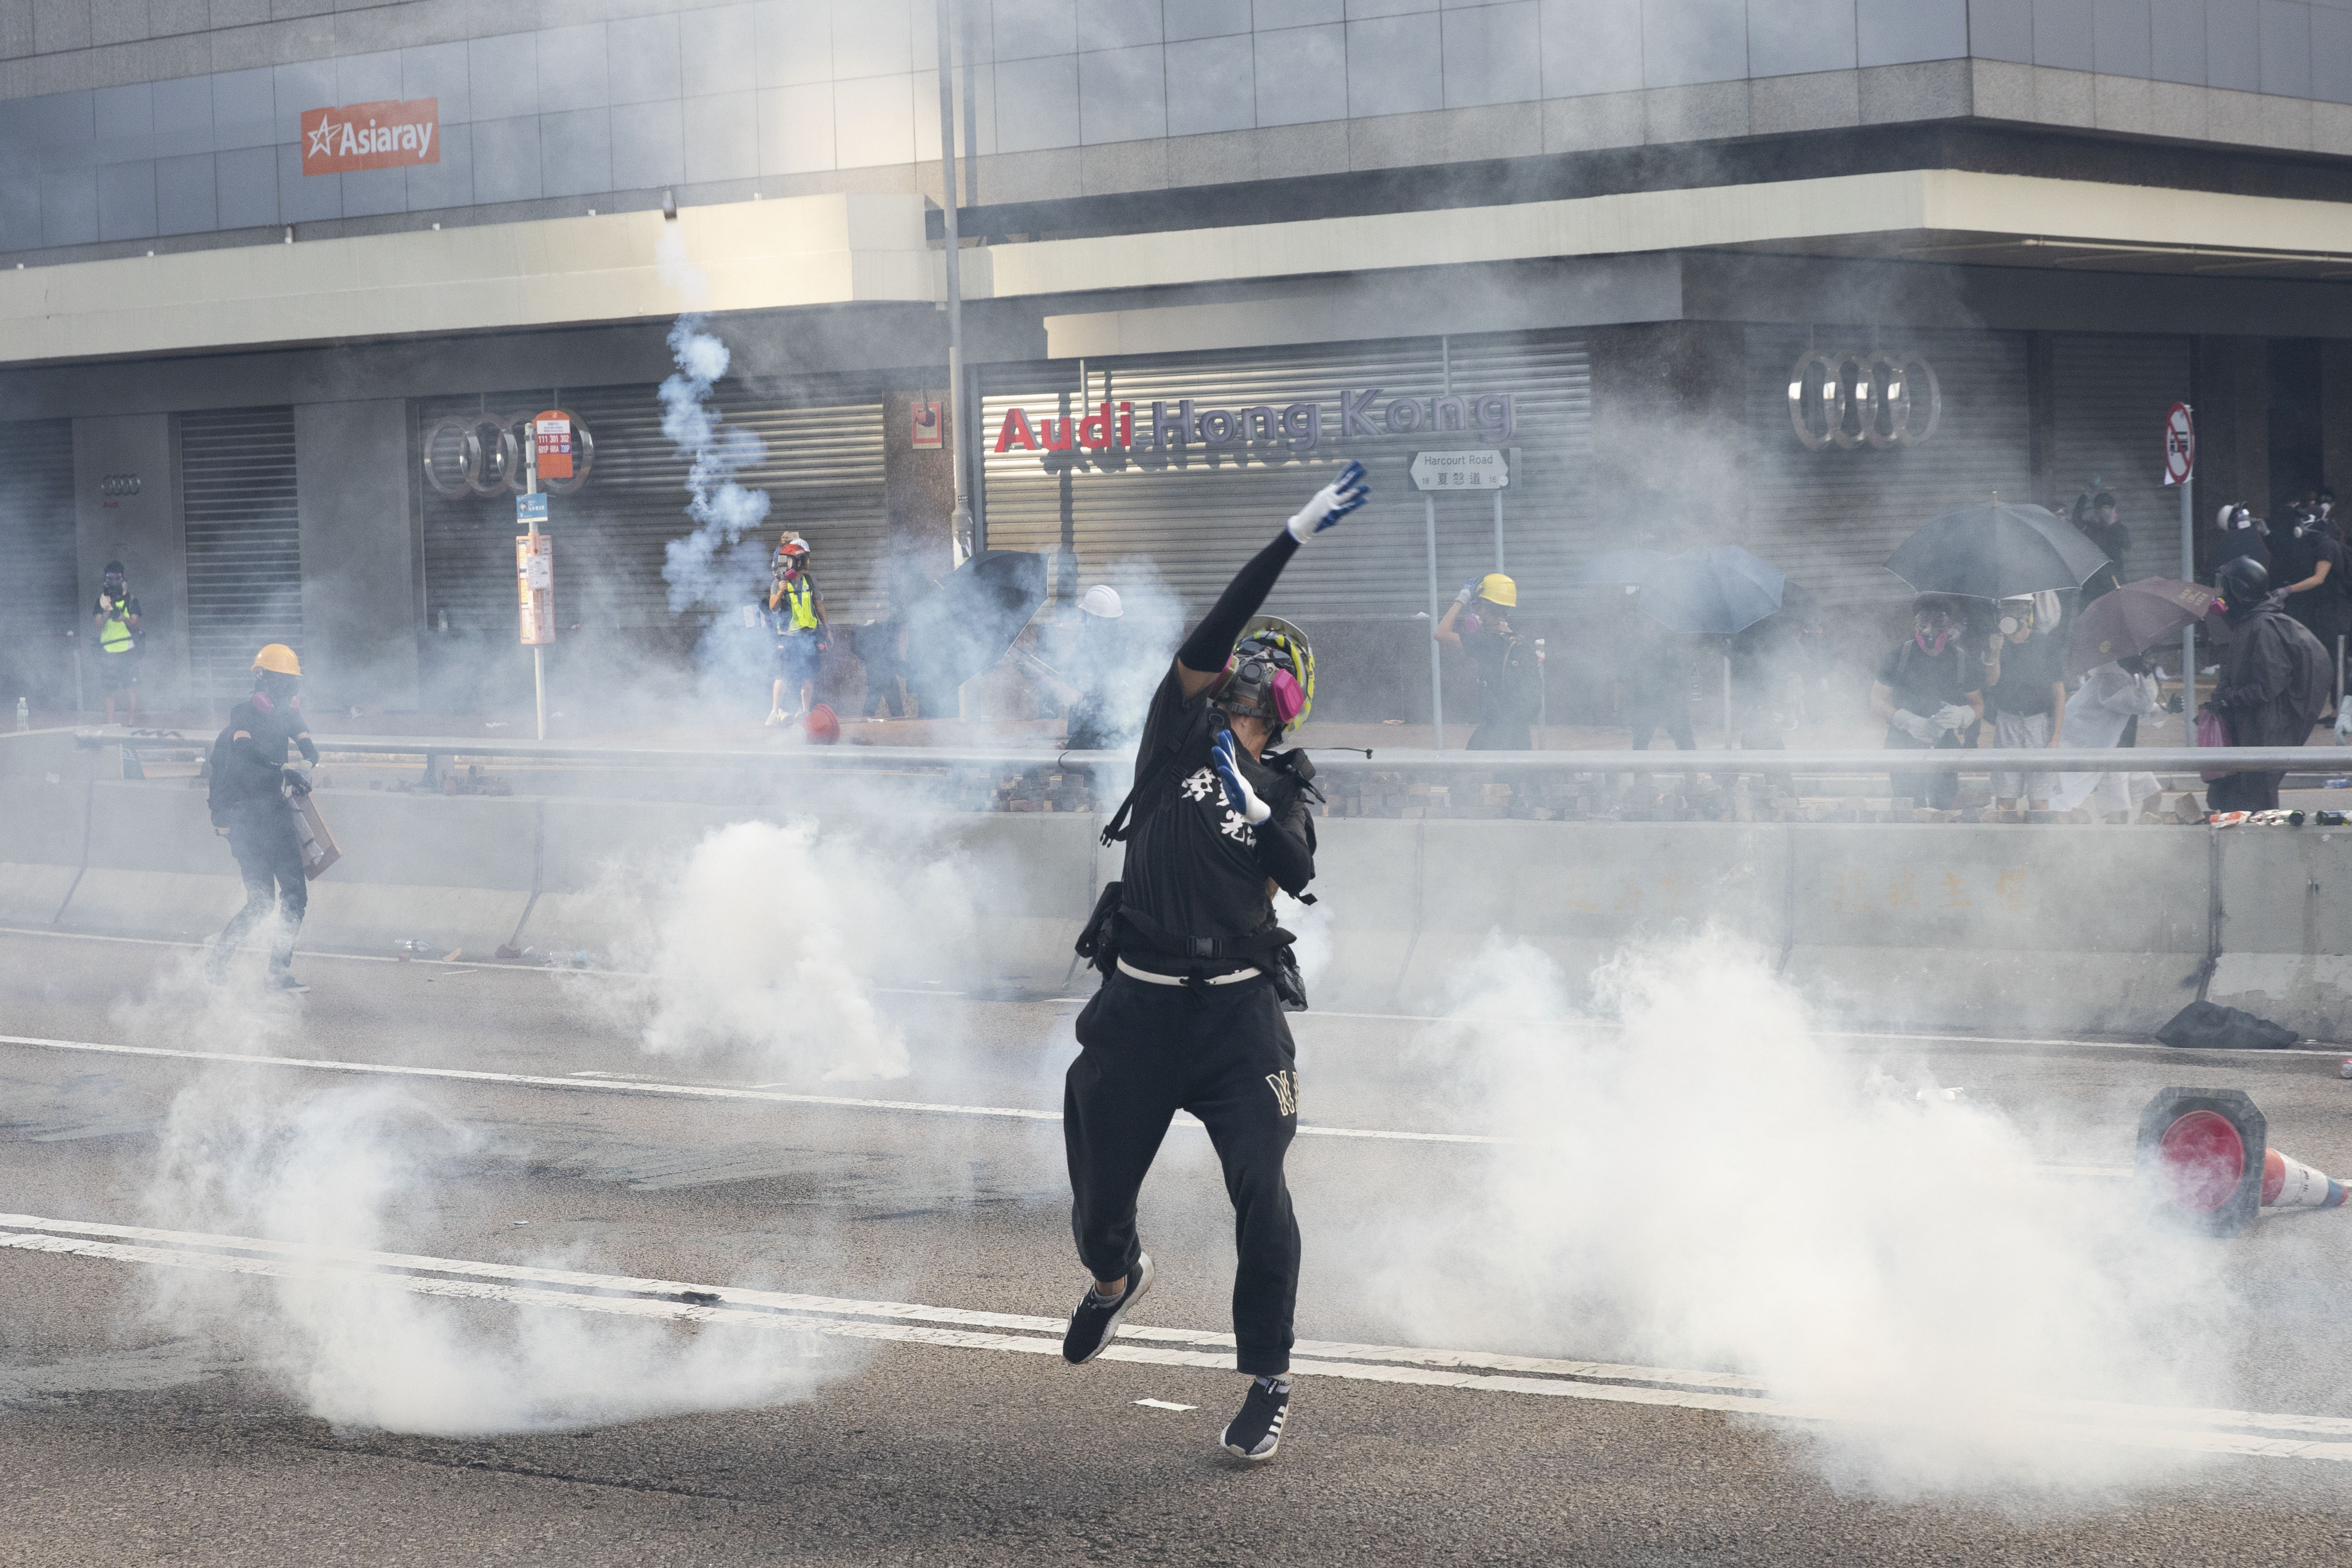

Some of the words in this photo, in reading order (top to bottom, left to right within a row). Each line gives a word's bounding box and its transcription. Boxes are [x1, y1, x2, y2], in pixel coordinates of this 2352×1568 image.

[339, 119, 433, 158] Asiaray
[994, 401, 1132, 453] Audi
[1153, 398, 1322, 451] Hong
[1339, 388, 1517, 443] Kong
[538, 435, 548, 444] 111
[549, 435, 558, 443] 301
[560, 434, 569, 443] 302
[1425, 455, 1465, 466] Harcourt
[1469, 455, 1493, 464] Road
